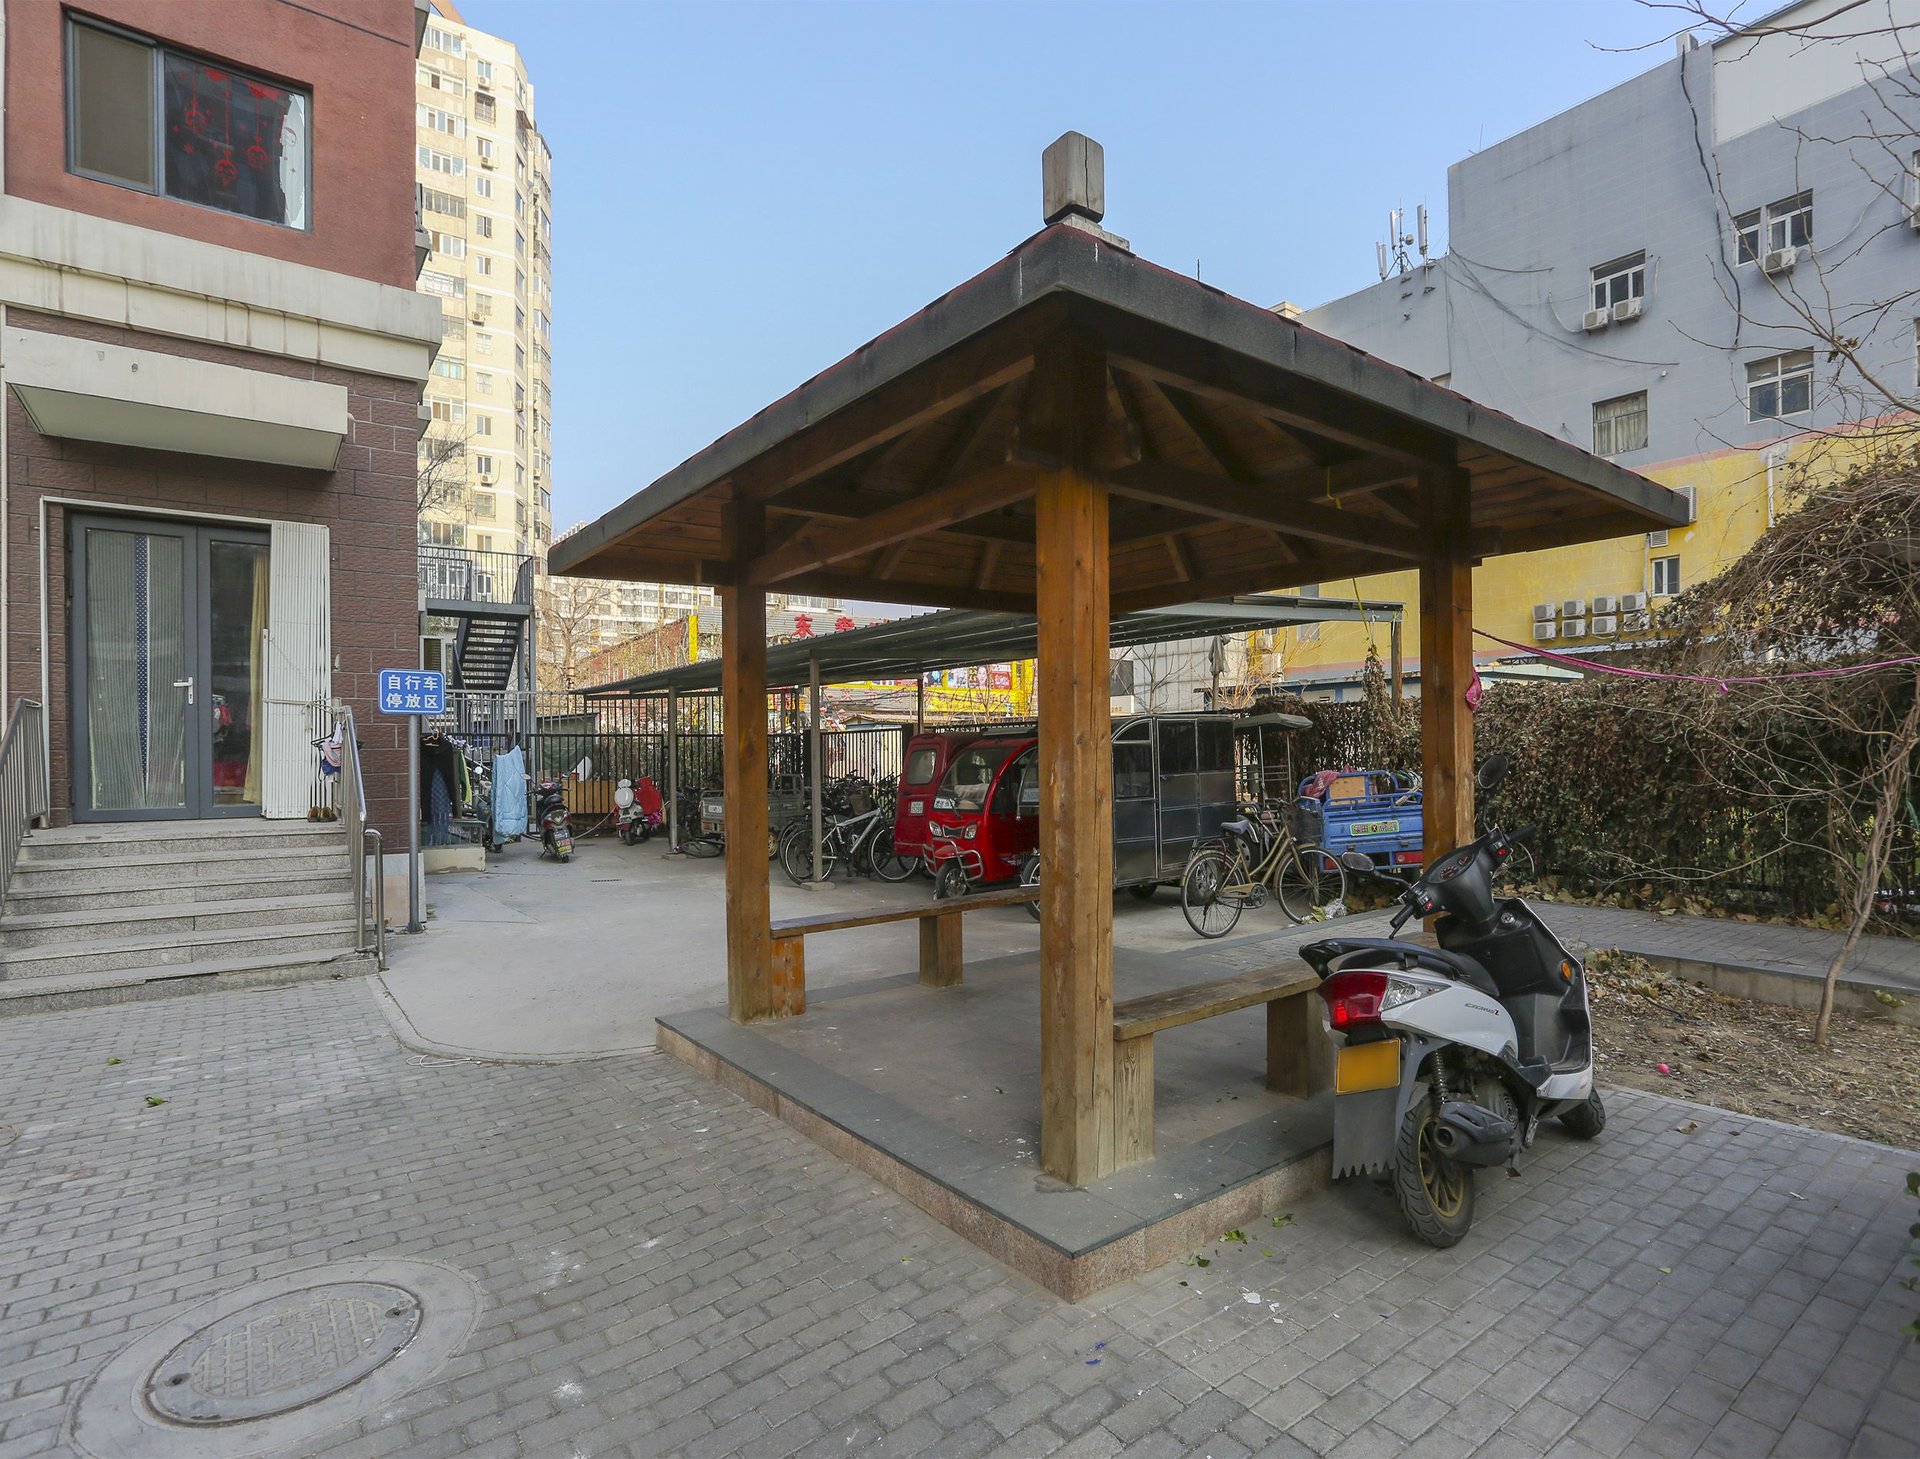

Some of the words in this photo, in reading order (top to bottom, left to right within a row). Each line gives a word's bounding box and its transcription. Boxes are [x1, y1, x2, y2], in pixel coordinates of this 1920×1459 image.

[388, 674, 439, 691] 自行车
[386, 692, 439, 709] 停放区
